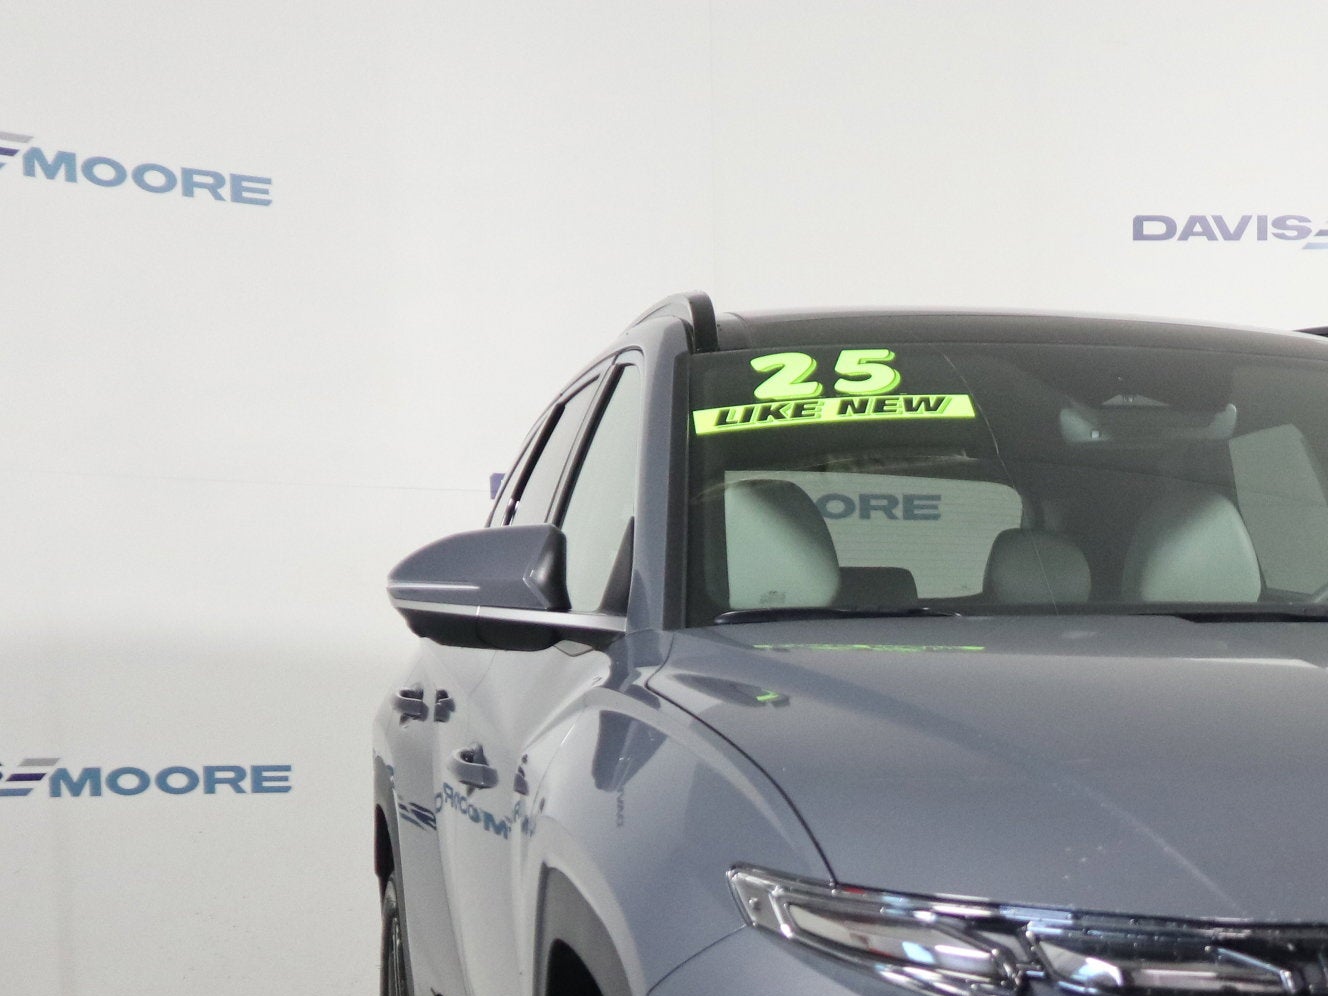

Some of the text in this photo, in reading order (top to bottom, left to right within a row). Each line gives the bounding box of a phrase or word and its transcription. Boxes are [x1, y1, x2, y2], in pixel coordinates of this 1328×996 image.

[22, 146, 273, 207] MOORE
[1132, 214, 1313, 242] DAVIS
[749, 348, 901, 400] 25
[714, 396, 950, 429] LIKE NEW
[815, 493, 942, 521] ORE
[48, 764, 293, 798] MOORE
